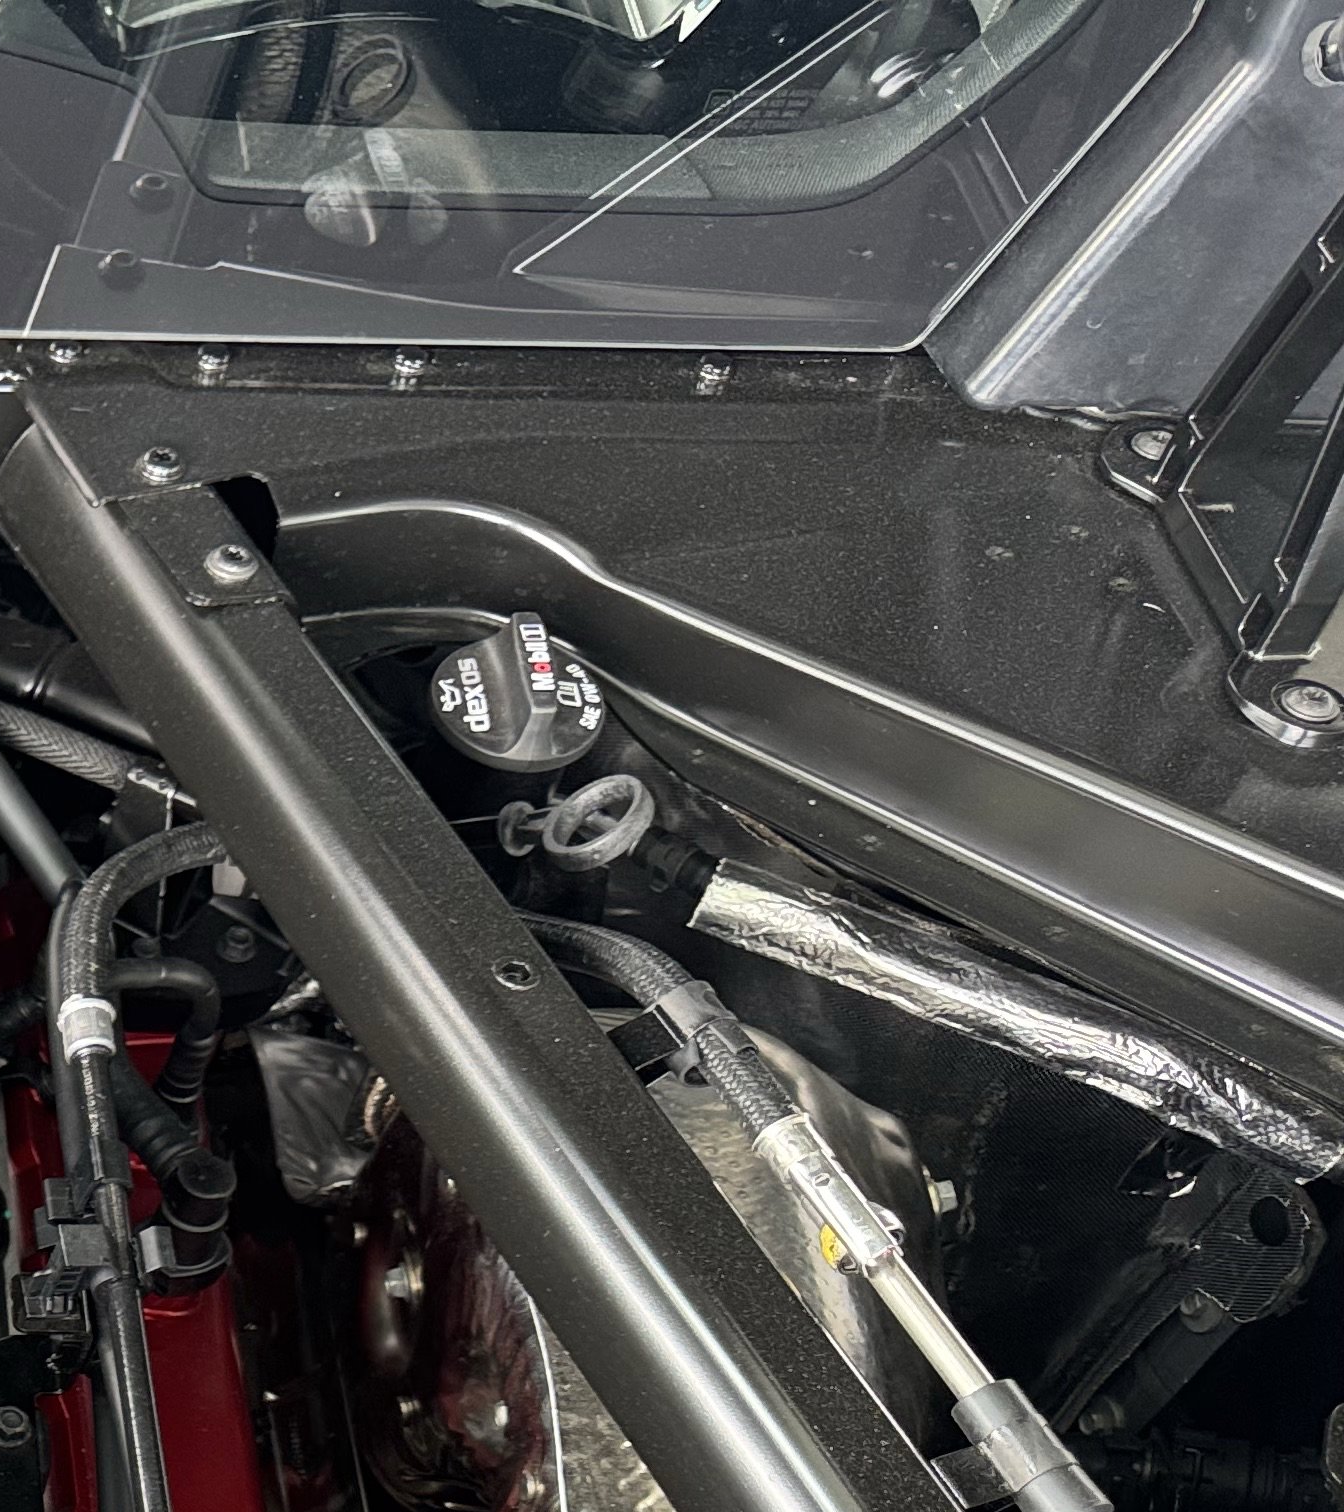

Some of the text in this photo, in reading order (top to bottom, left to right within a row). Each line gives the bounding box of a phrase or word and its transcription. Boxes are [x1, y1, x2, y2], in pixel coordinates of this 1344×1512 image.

[457, 657, 490, 732] dexos
[525, 642, 555, 690] Mobil
[565, 663, 601, 730] SAE 0W-40
